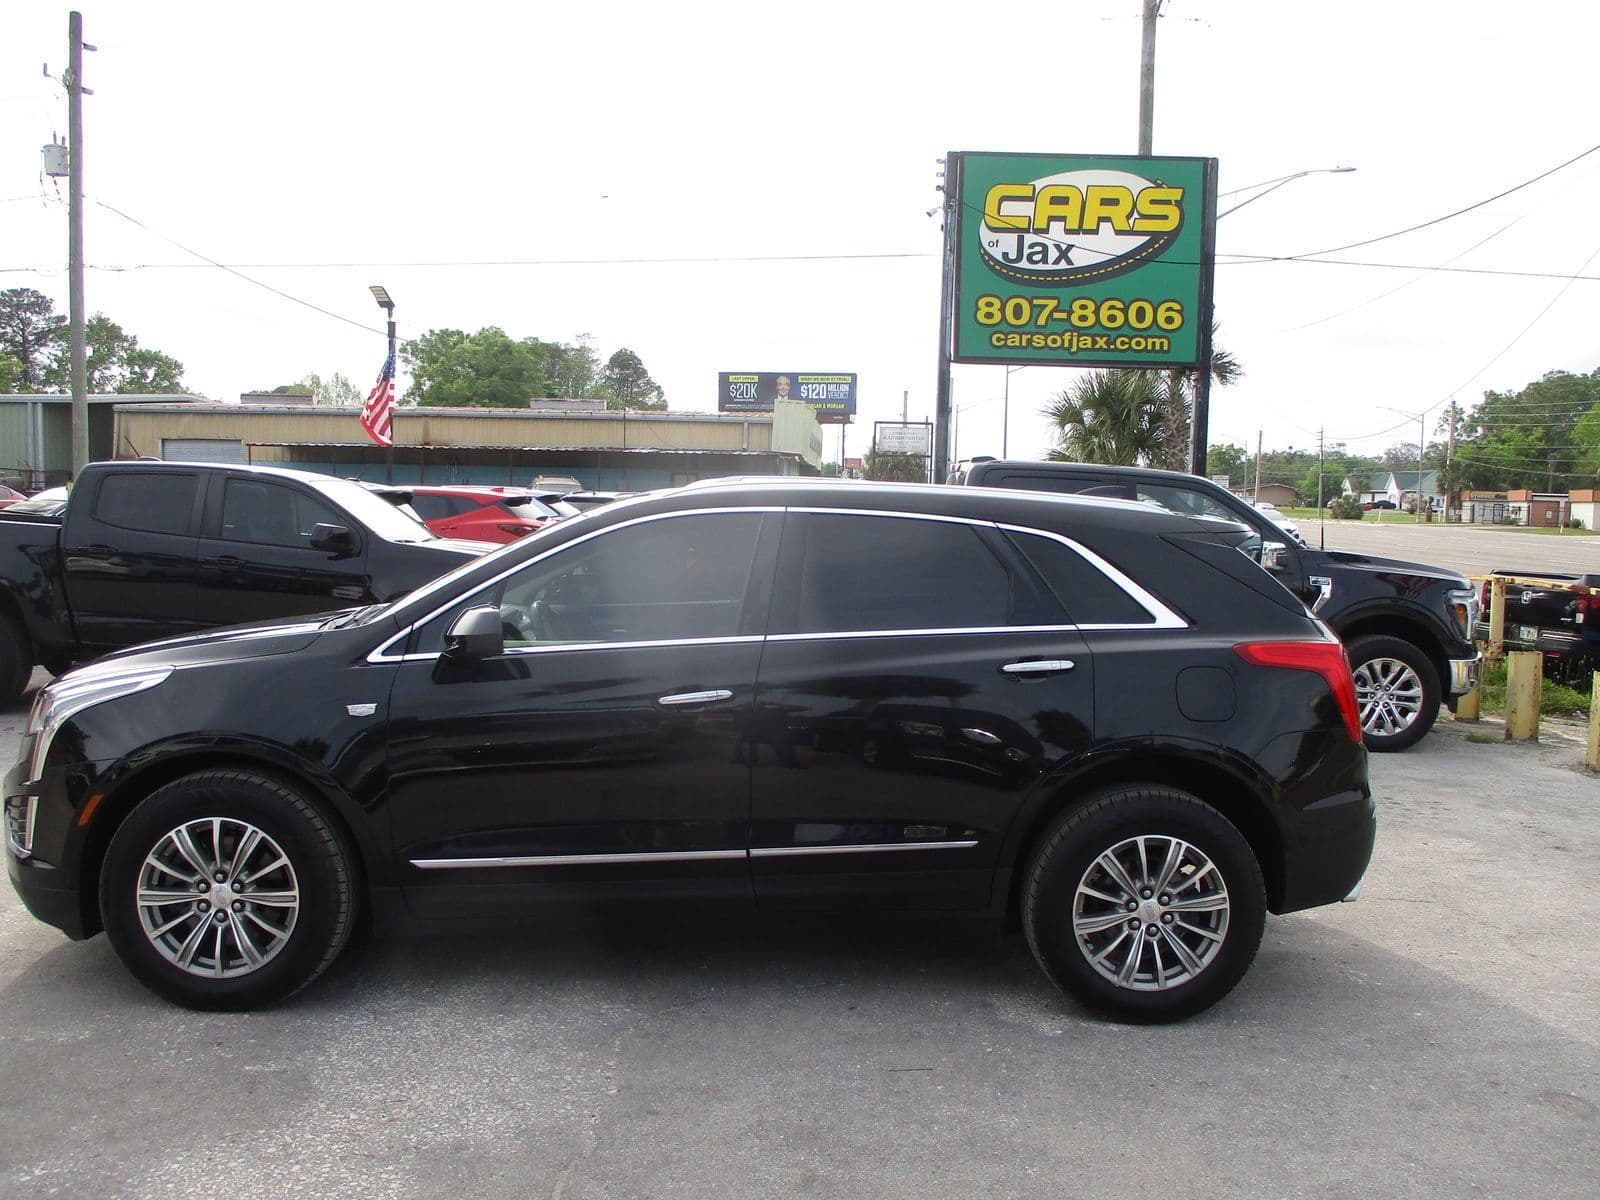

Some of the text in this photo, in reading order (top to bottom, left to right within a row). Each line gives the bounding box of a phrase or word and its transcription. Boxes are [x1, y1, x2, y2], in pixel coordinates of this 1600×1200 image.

[983, 183, 1185, 235] CARS
[987, 234, 1076, 266] of Jax
[975, 296, 1184, 331] 807-8606
[991, 331, 1170, 353] carsofjax.com
[730, 383, 758, 399] $20K
[800, 383, 827, 399] $120
